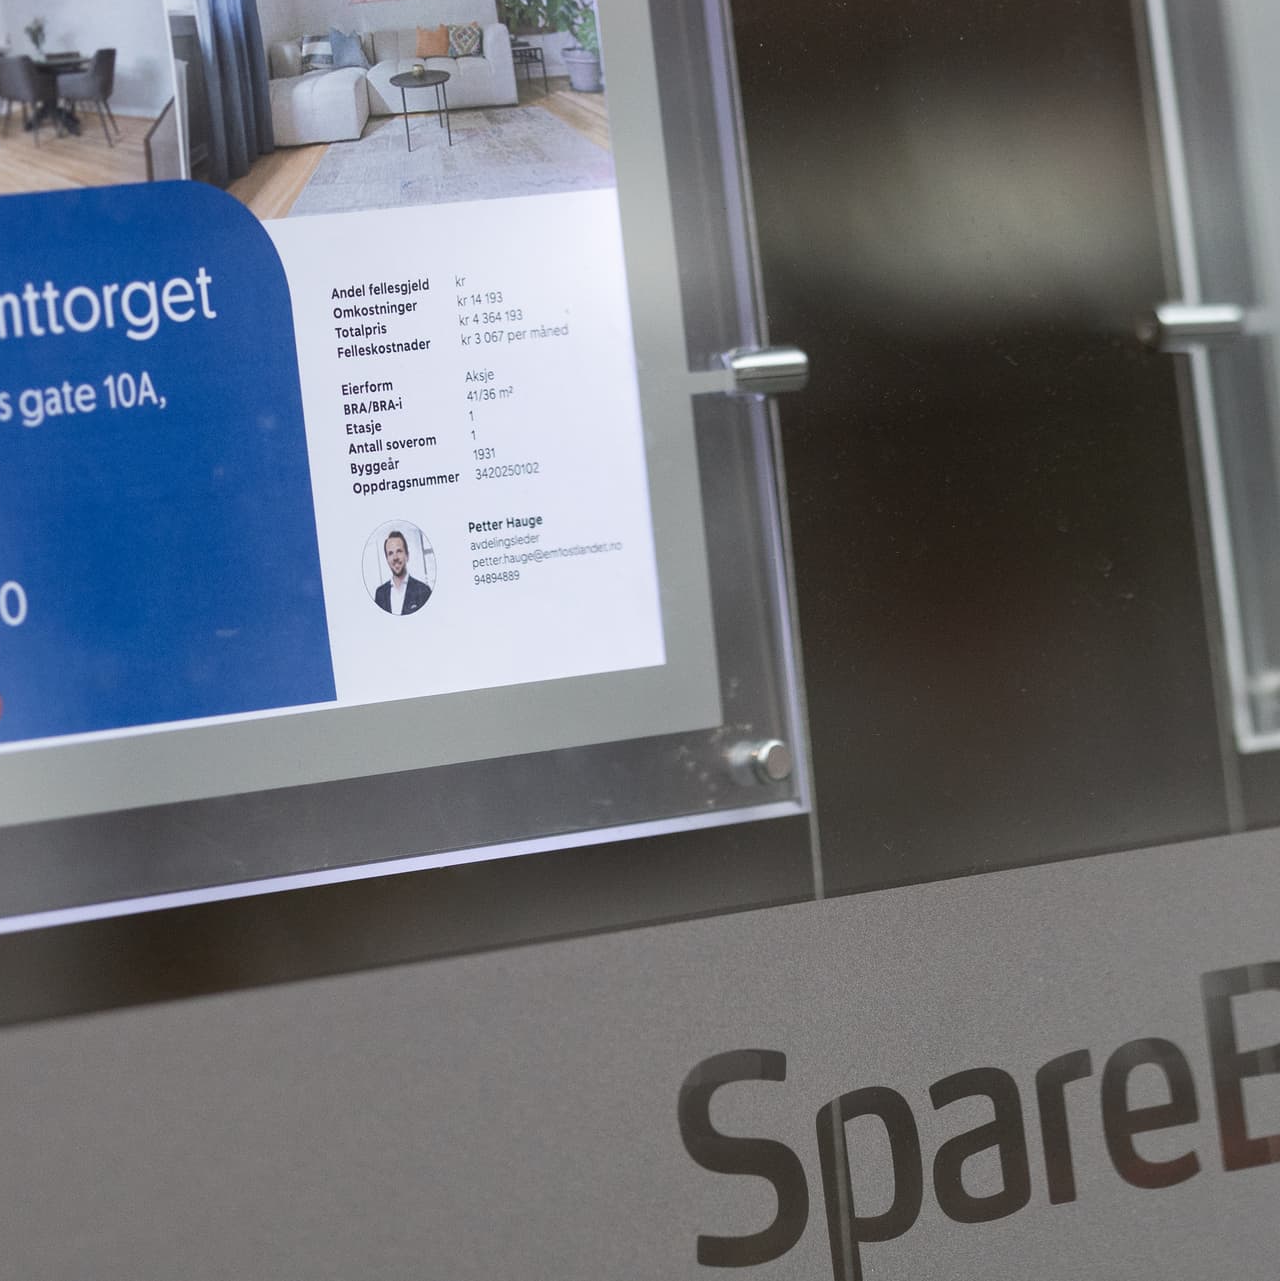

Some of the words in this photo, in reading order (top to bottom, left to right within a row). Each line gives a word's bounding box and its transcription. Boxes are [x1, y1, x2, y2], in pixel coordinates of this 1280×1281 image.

[331, 285, 365, 299] Andel
[369, 278, 429, 296] fellesgjeld
[455, 275, 466, 287] kr
[457, 294, 468, 307] kr
[470, 293, 482, 305] 14
[485, 291, 503, 304] 193
[333, 301, 417, 319] Omkostninger
[458, 314, 469, 326] kr
[472, 313, 479, 325] 4
[482, 311, 502, 324] 364
[505, 309, 523, 322] 193
[335, 322, 387, 339] Totalpris
[461, 333, 472, 346] kr
[474, 332, 481, 344] 3
[484, 330, 504, 343] 067
[508, 330, 527, 343] per
[530, 324, 569, 340] måned
[337, 338, 431, 358] Felleskostnader
[465, 368, 495, 383] Aksje
[341, 381, 393, 396] Eierform
[466, 388, 496, 402] 41/36
[19, 380, 96, 427] gate
[103, 371, 167, 411] 10A,
[344, 397, 402, 415] BRA/BRA-i
[346, 420, 382, 435] Etasje
[348, 439, 383, 455] Antall
[386, 436, 437, 451] soverom
[473, 447, 496, 460] 1931
[350, 457, 400, 477] Byggeår
[353, 473, 460, 496] Oppdragsnummer
[468, 519, 503, 534] Petter
[506, 516, 543, 530] Hauge
[470, 534, 540, 551] avdelingsleder
